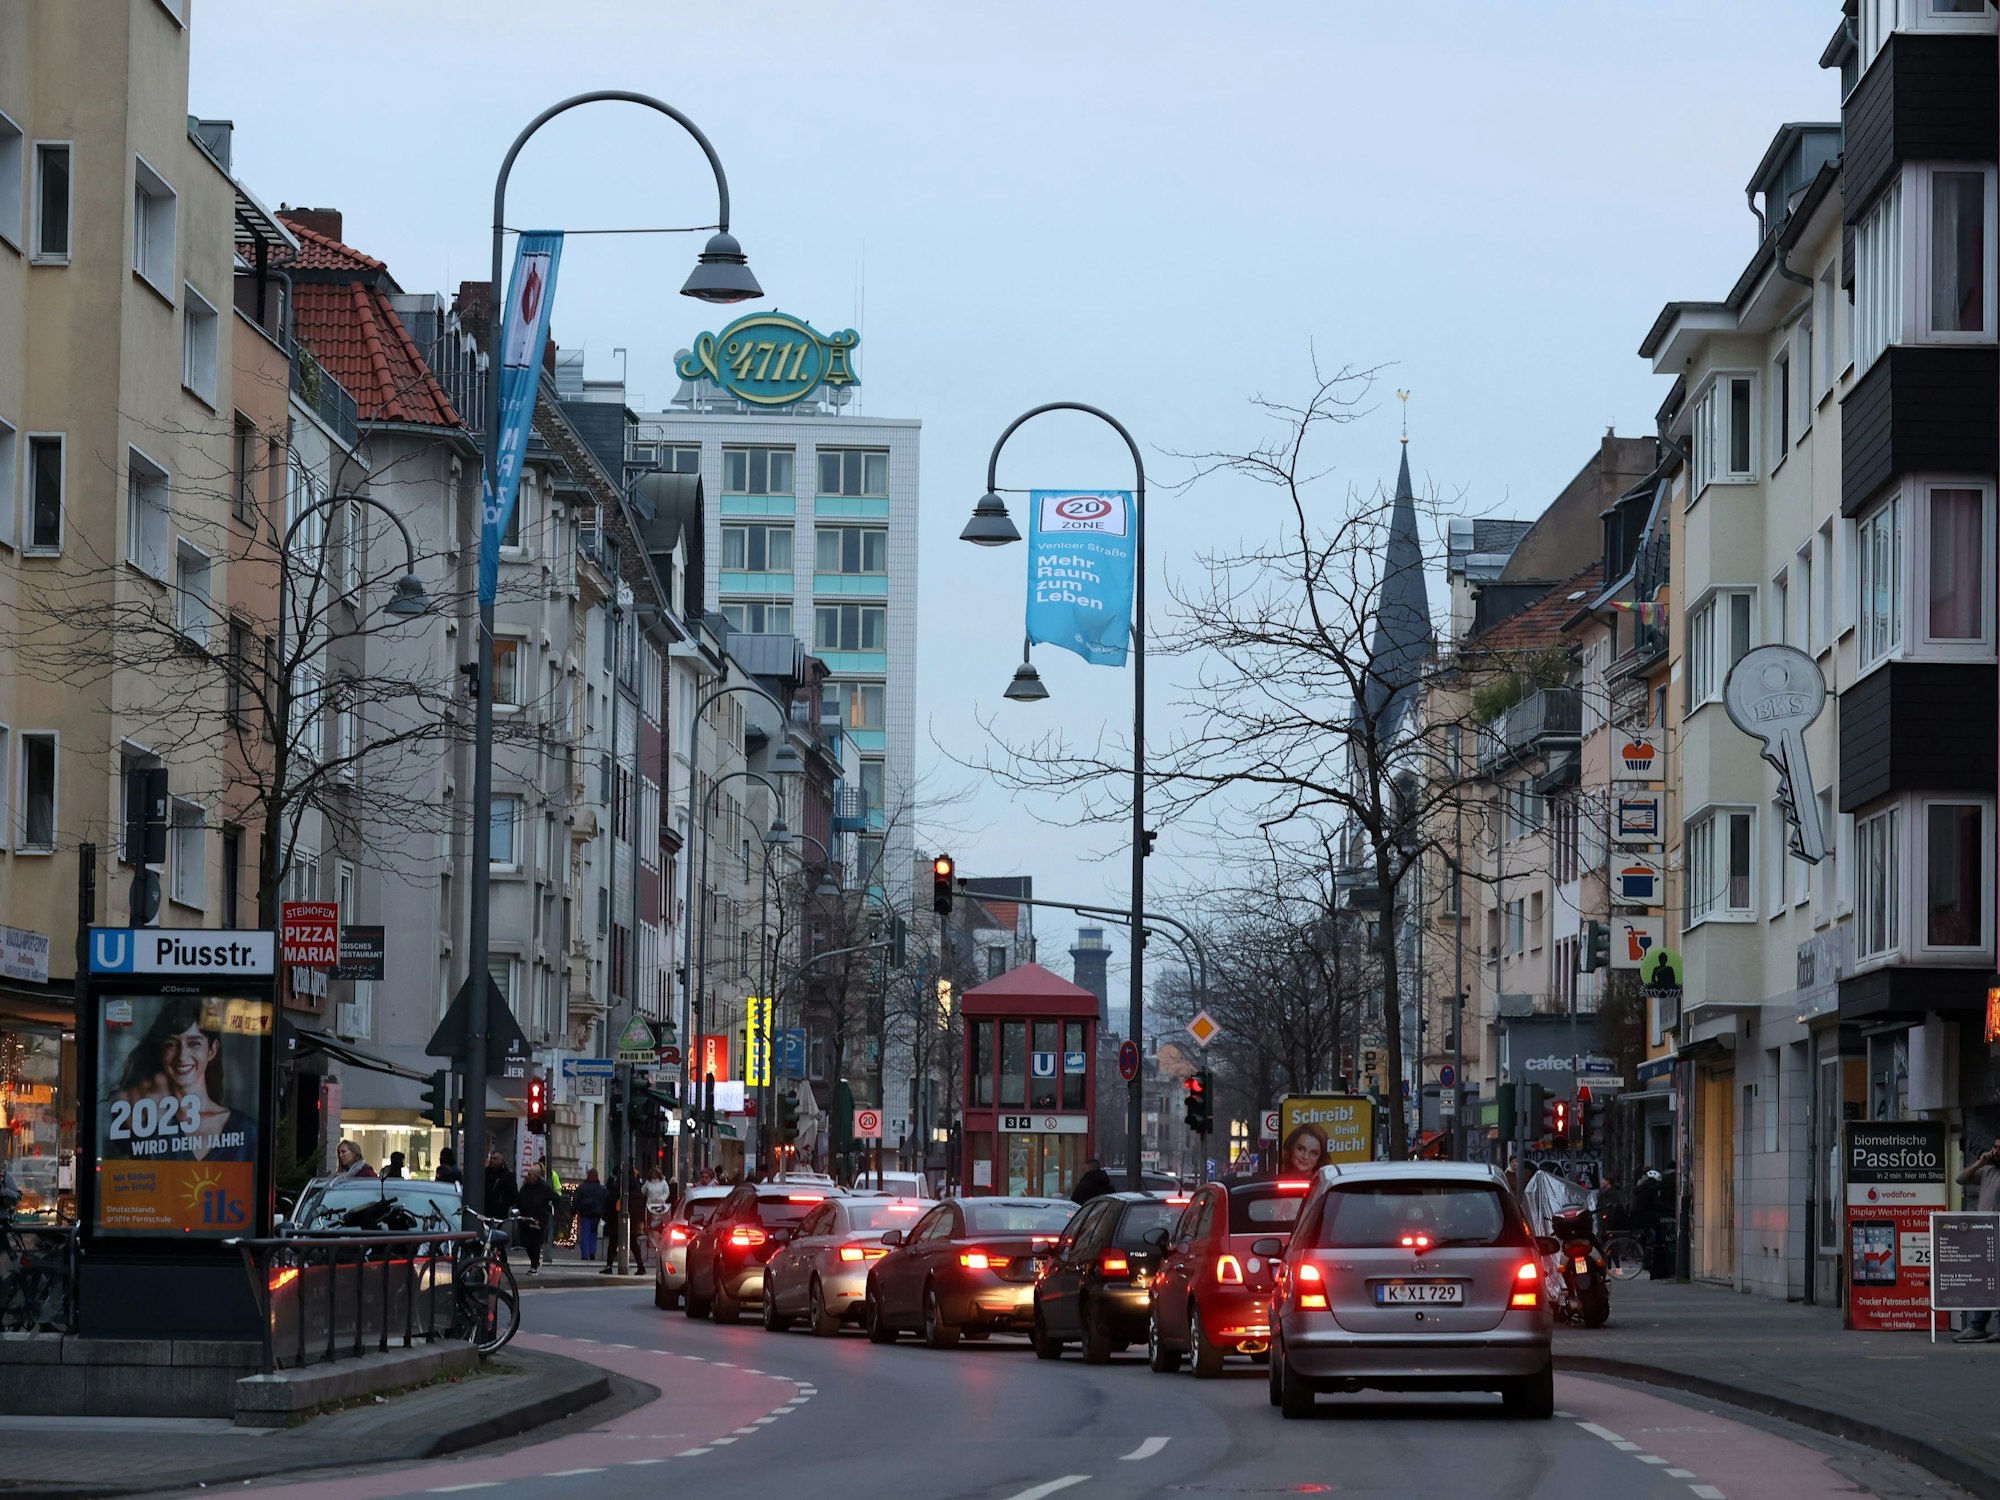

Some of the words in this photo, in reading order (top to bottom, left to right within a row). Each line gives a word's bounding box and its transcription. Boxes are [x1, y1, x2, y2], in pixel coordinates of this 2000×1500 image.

[1068, 501, 1100, 514] 20
[1062, 521, 1105, 529] ZONE
[1037, 542, 1084, 550] Venloer
[1087, 542, 1127, 558] Straße
[1038, 555, 1095, 569] Mehr
[1037, 566, 1100, 584] Raum
[1036, 579, 1082, 592] zum
[1037, 591, 1103, 610] Leben
[1754, 695, 1804, 721] BKS
[286, 906, 335, 919] STEINOFEN
[285, 926, 335, 942] PIZZA
[97, 933, 126, 968] U
[157, 938, 256, 966] Piusstr.
[283, 946, 335, 962] MARIA
[160, 985, 200, 993] JCDecaux
[1033, 1054, 1055, 1076] U
[109, 1094, 201, 1140] 2023
[863, 1117, 874, 1126] 20
[1292, 1106, 1354, 1124] Schreib!
[1006, 1118, 1015, 1128] 3
[1020, 1118, 1029, 1128] 4
[1335, 1124, 1360, 1135] Dein!
[131, 1139, 168, 1156] WIRD
[171, 1135, 202, 1151] DEIN
[206, 1131, 245, 1149] JAHR!
[1327, 1137, 1365, 1153] Buch!
[1854, 1134, 1927, 1146] biometrische
[1853, 1148, 1937, 1167] Passfoto
[1928, 1172, 1945, 1181] Shop
[1881, 1190, 1916, 1199] vodafone
[106, 1205, 156, 1213] Deutschlands
[203, 1189, 245, 1224] ils
[1850, 1208, 1873, 1217] Display
[1877, 1207, 1909, 1216] Wechsel
[1389, 1287, 1398, 1300] K
[1408, 1287, 1425, 1300] XI
[1429, 1287, 1456, 1300] 729
[1883, 1297, 1909, 1306] Patronen
[1893, 1321, 1915, 1329] Handys
